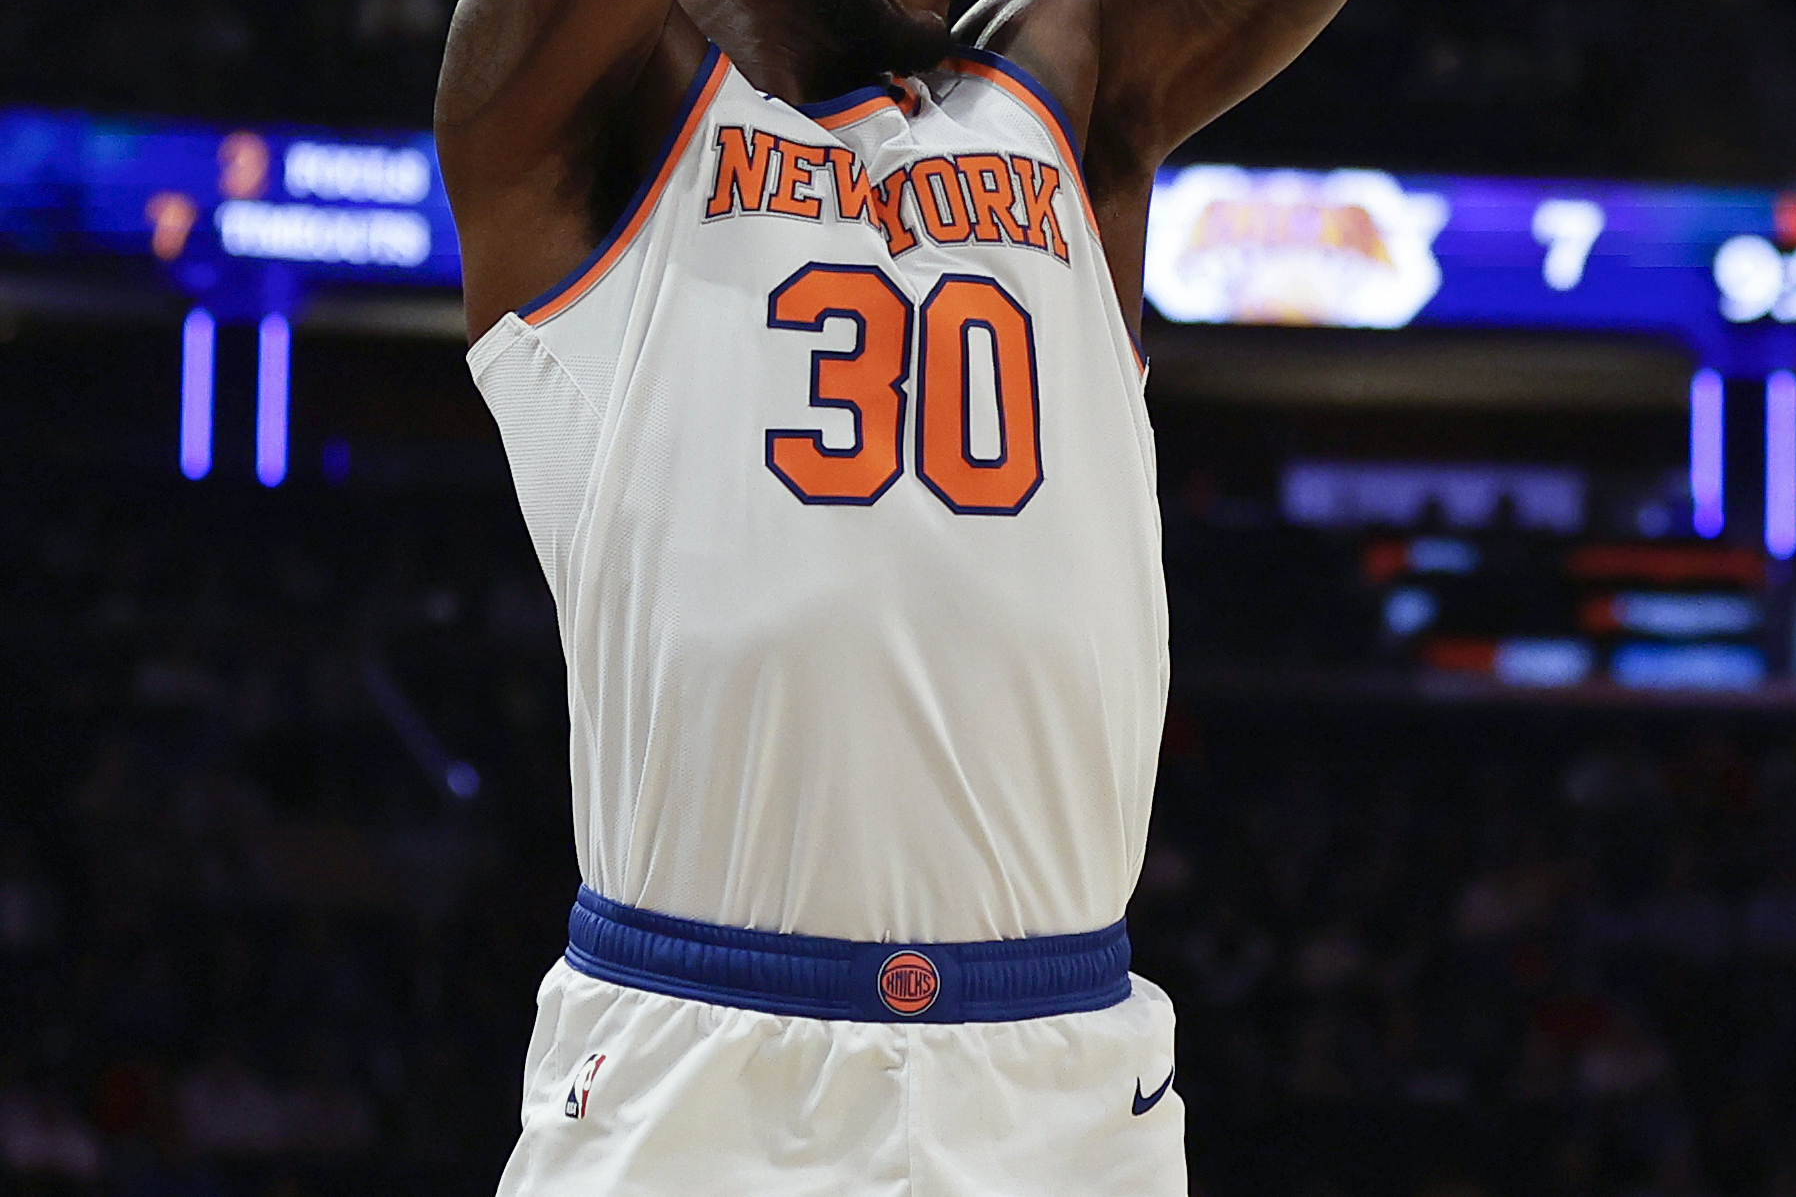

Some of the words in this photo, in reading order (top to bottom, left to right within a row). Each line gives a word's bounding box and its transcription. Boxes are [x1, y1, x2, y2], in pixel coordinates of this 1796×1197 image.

[701, 124, 882, 232] NEW
[872, 152, 1071, 269] YORK
[1531, 198, 1606, 291] 7
[766, 261, 1044, 516] 30
